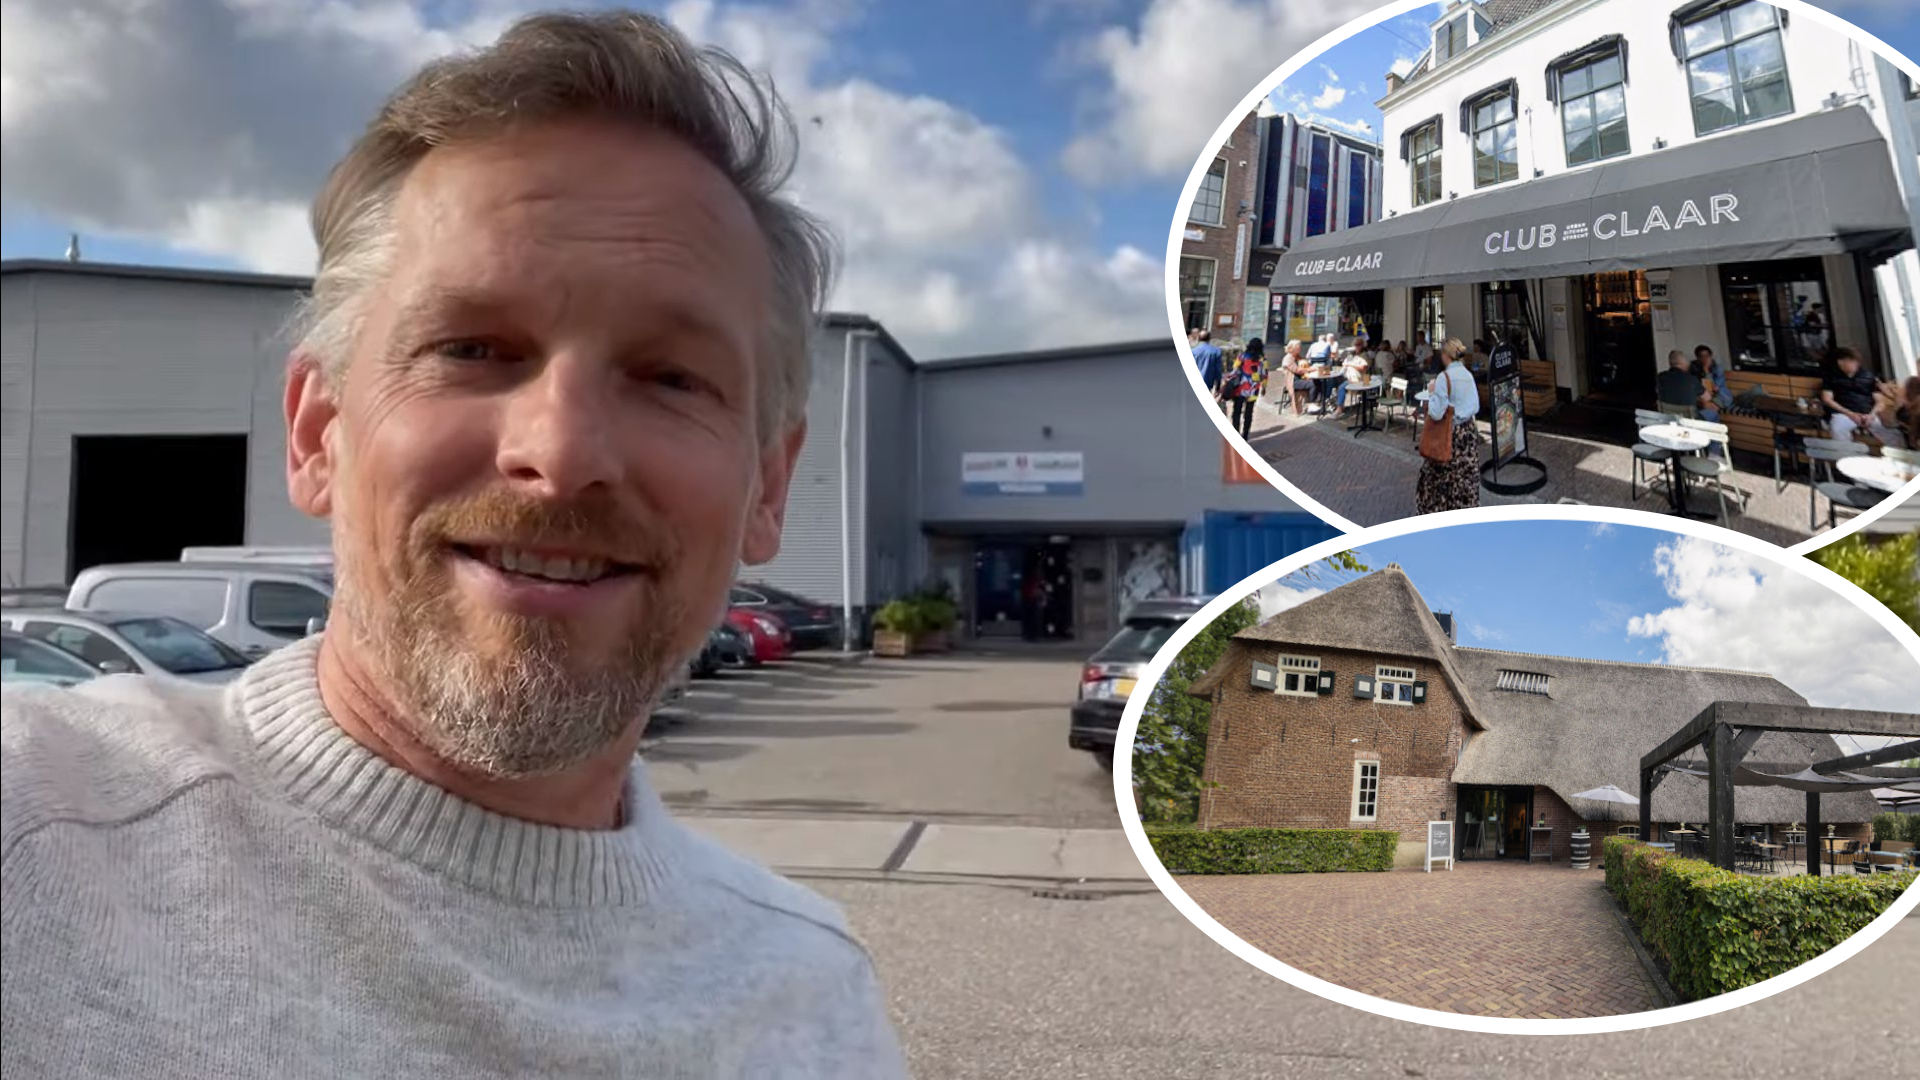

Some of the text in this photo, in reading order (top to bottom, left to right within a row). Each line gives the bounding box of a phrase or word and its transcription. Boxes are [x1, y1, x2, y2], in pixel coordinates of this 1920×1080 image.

[1484, 193, 1739, 255] CLUB CLAAR
[1295, 252, 1383, 276] CLUB CLAAR
[1650, 284, 1667, 292] PIN
